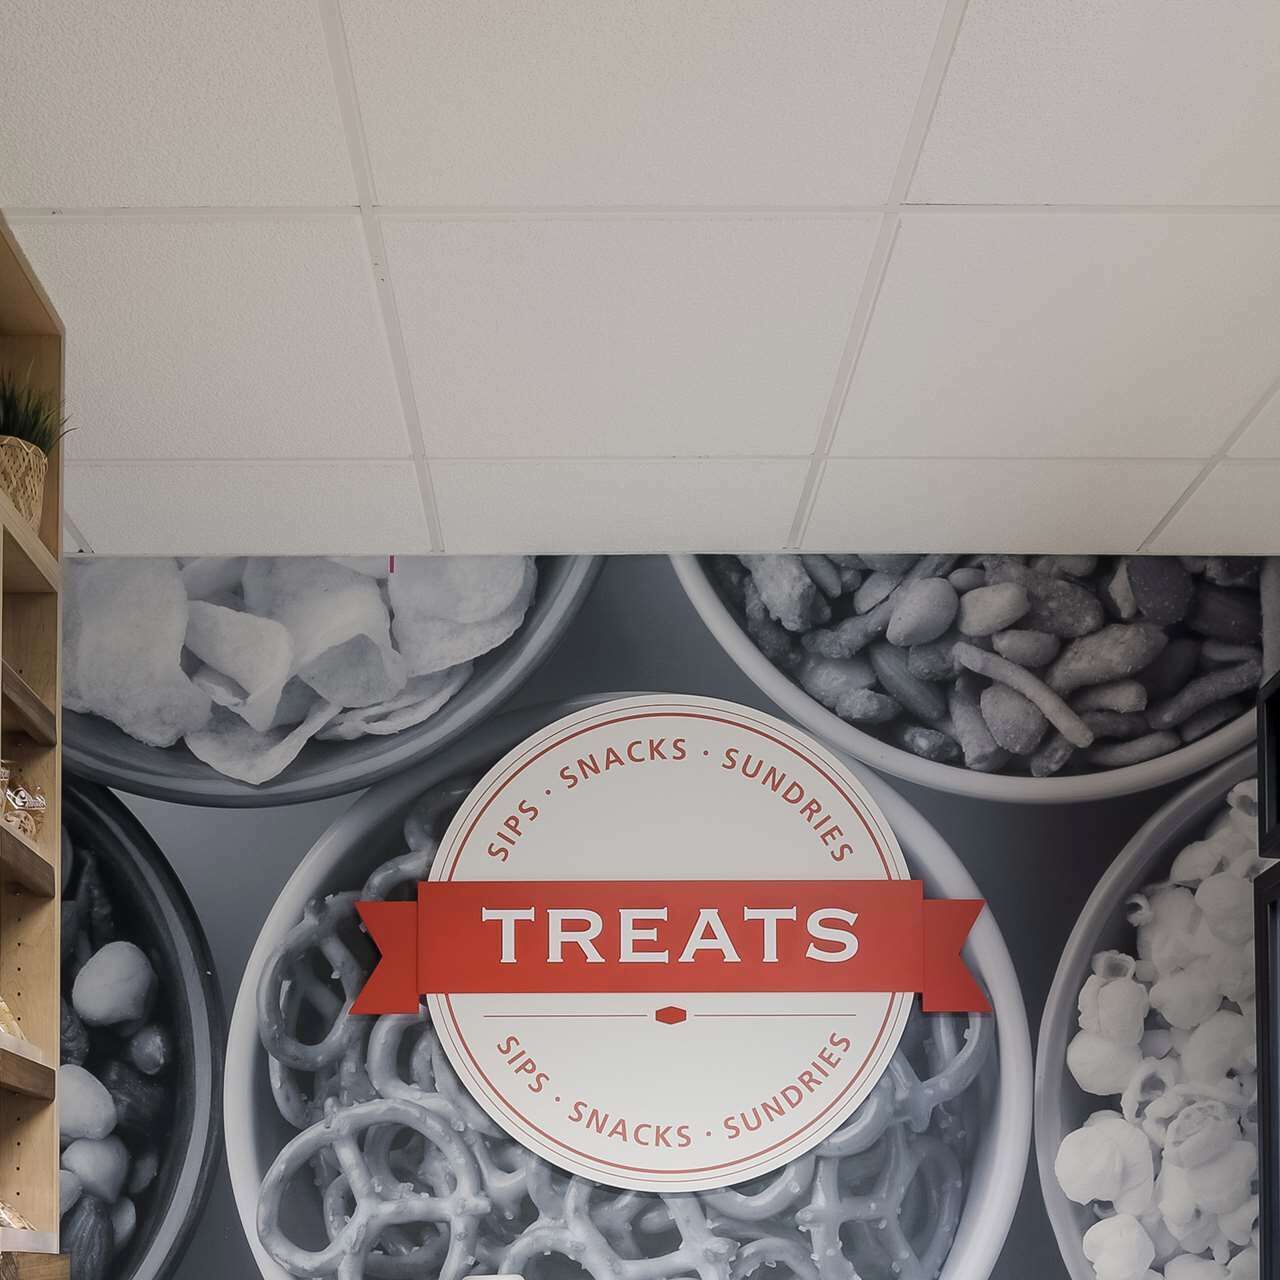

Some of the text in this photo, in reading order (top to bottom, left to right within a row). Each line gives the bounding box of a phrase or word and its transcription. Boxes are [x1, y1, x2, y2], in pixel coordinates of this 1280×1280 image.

[487, 737, 854, 863] SIPS SNACKS SUNDRIES
[481, 906, 860, 964] TREATS
[496, 1031, 853, 1149] SIPS SNACKS SUNDRIES
